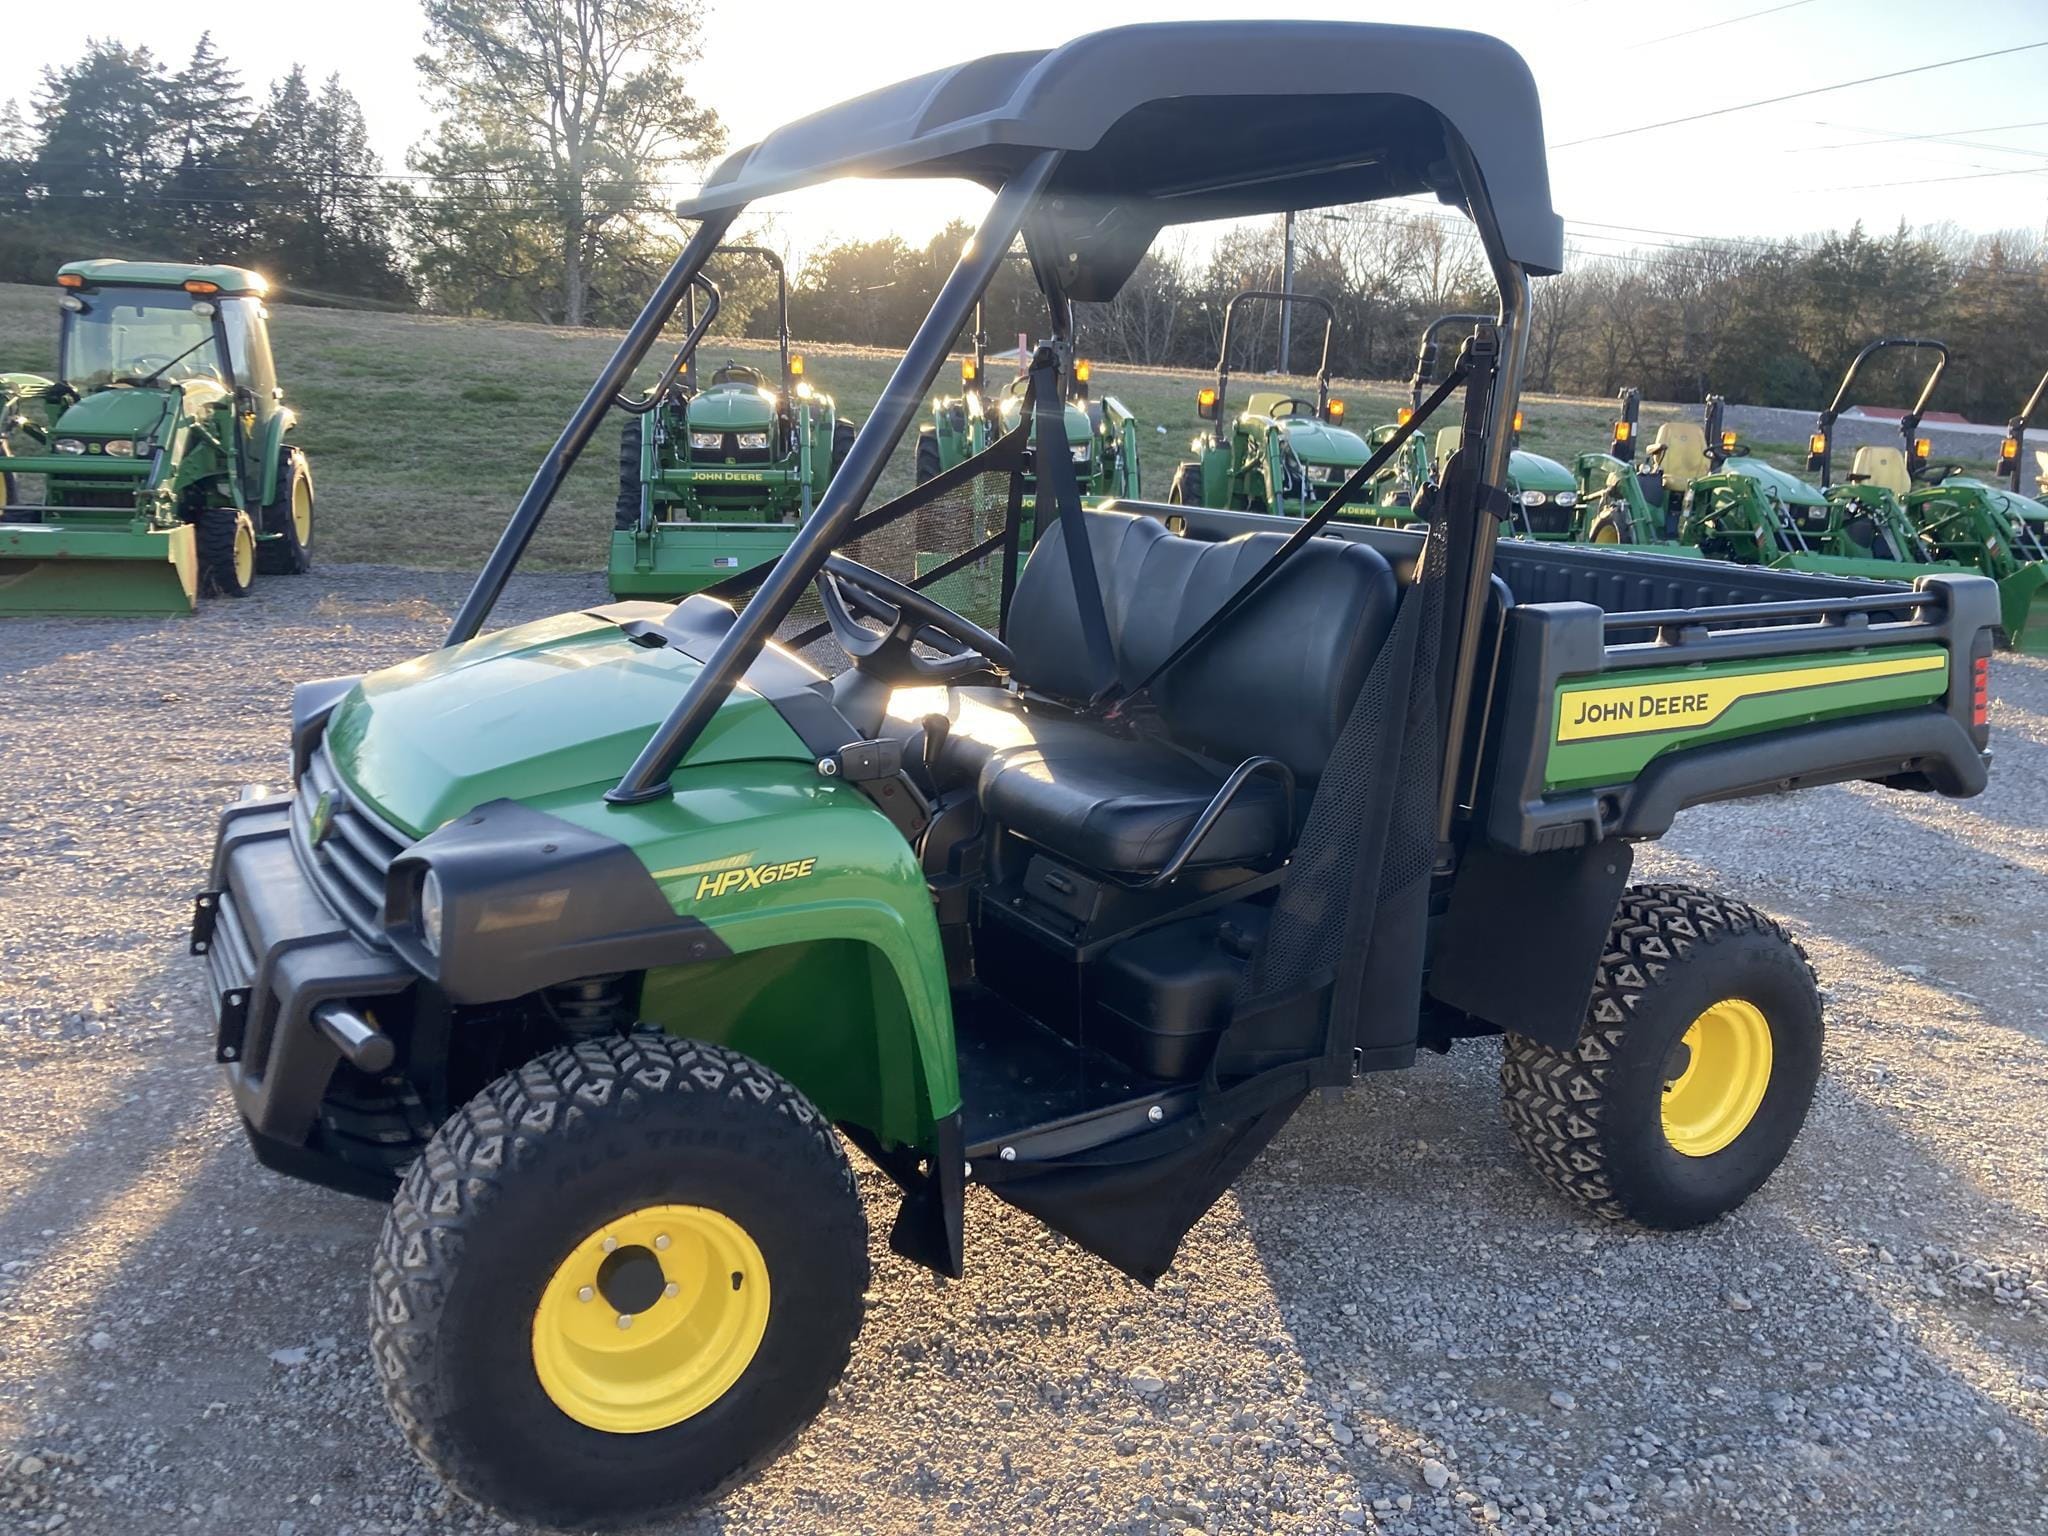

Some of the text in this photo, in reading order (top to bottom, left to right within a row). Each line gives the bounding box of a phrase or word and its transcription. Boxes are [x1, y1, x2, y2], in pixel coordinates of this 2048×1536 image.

[692, 472, 763, 481] JOHN DEERE
[1347, 506, 1377, 515] DEERE
[1574, 694, 1708, 724] JOHN DEERE
[695, 856, 818, 901] HPX615E
